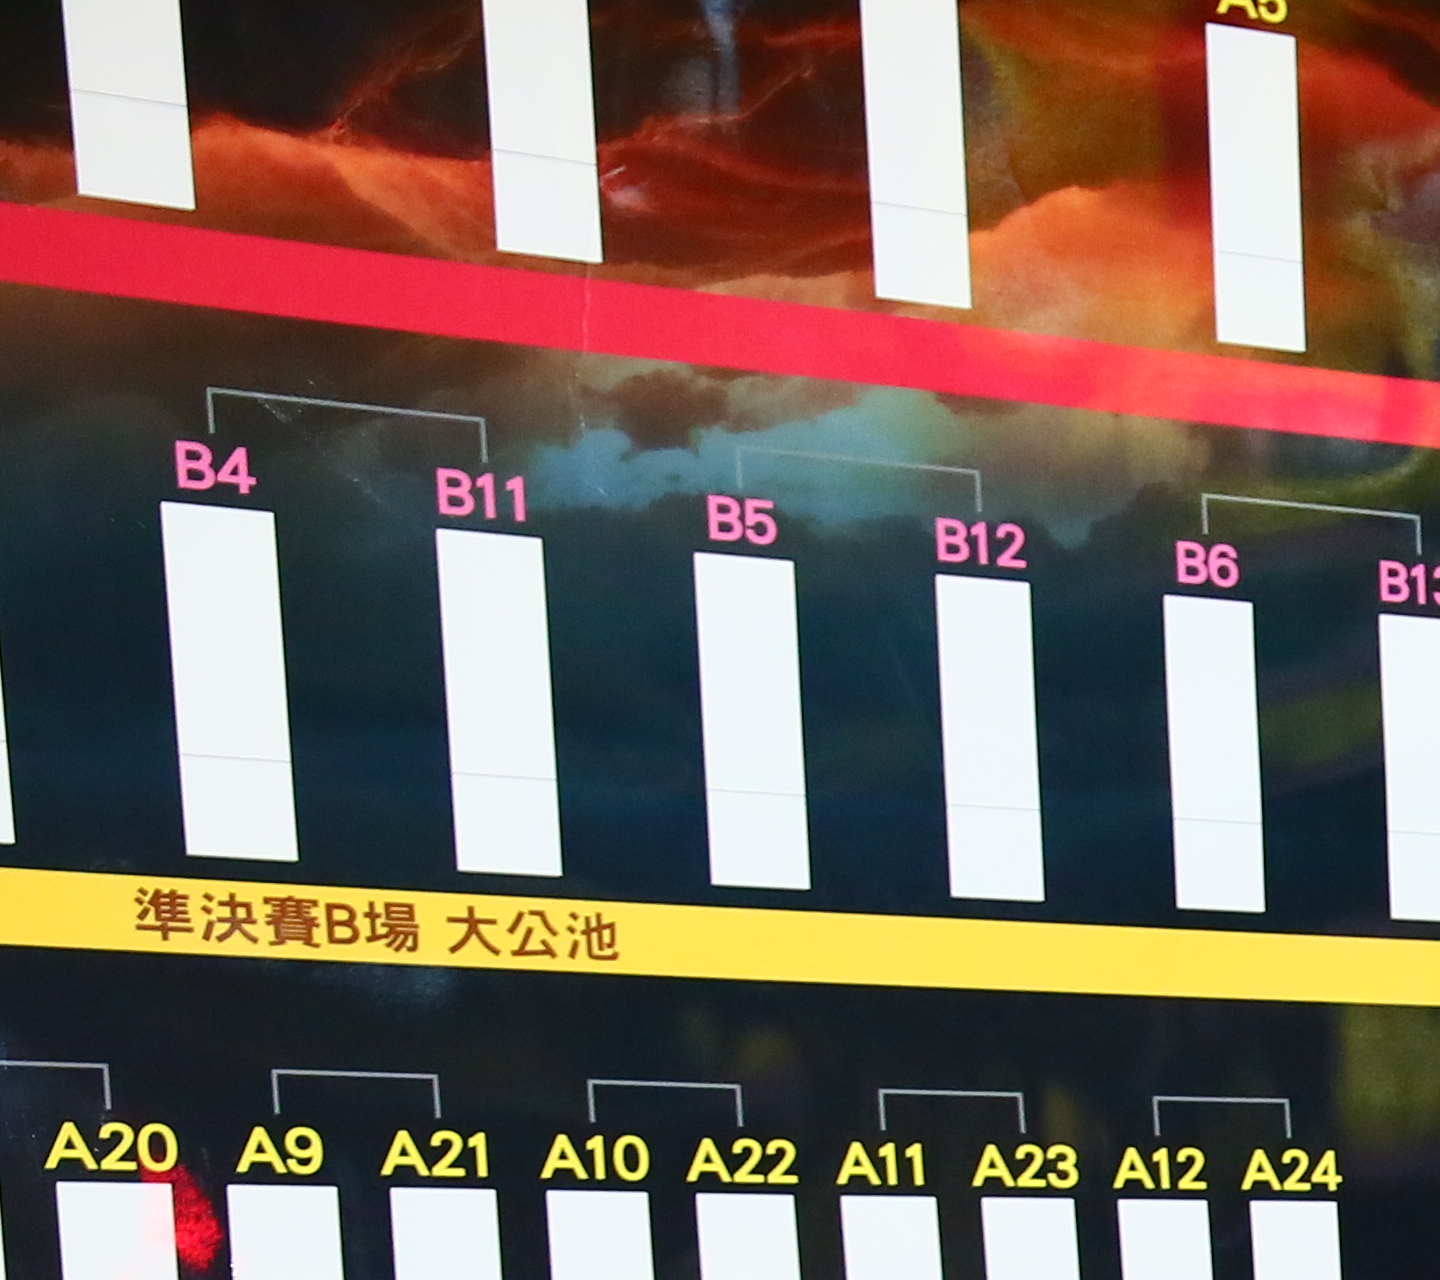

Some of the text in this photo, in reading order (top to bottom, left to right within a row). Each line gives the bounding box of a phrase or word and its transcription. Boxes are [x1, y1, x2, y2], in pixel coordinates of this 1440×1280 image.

[174, 439, 257, 495] B4
[435, 467, 527, 523] B11
[706, 494, 778, 546] B5
[934, 517, 1028, 569] B12
[1174, 540, 1240, 589] B6
[134, 885, 621, 962] 準決賽B場 大公池
[44, 1121, 1343, 1192] A20 A9 A21 A10 A22 A11 A23 A12 A24
